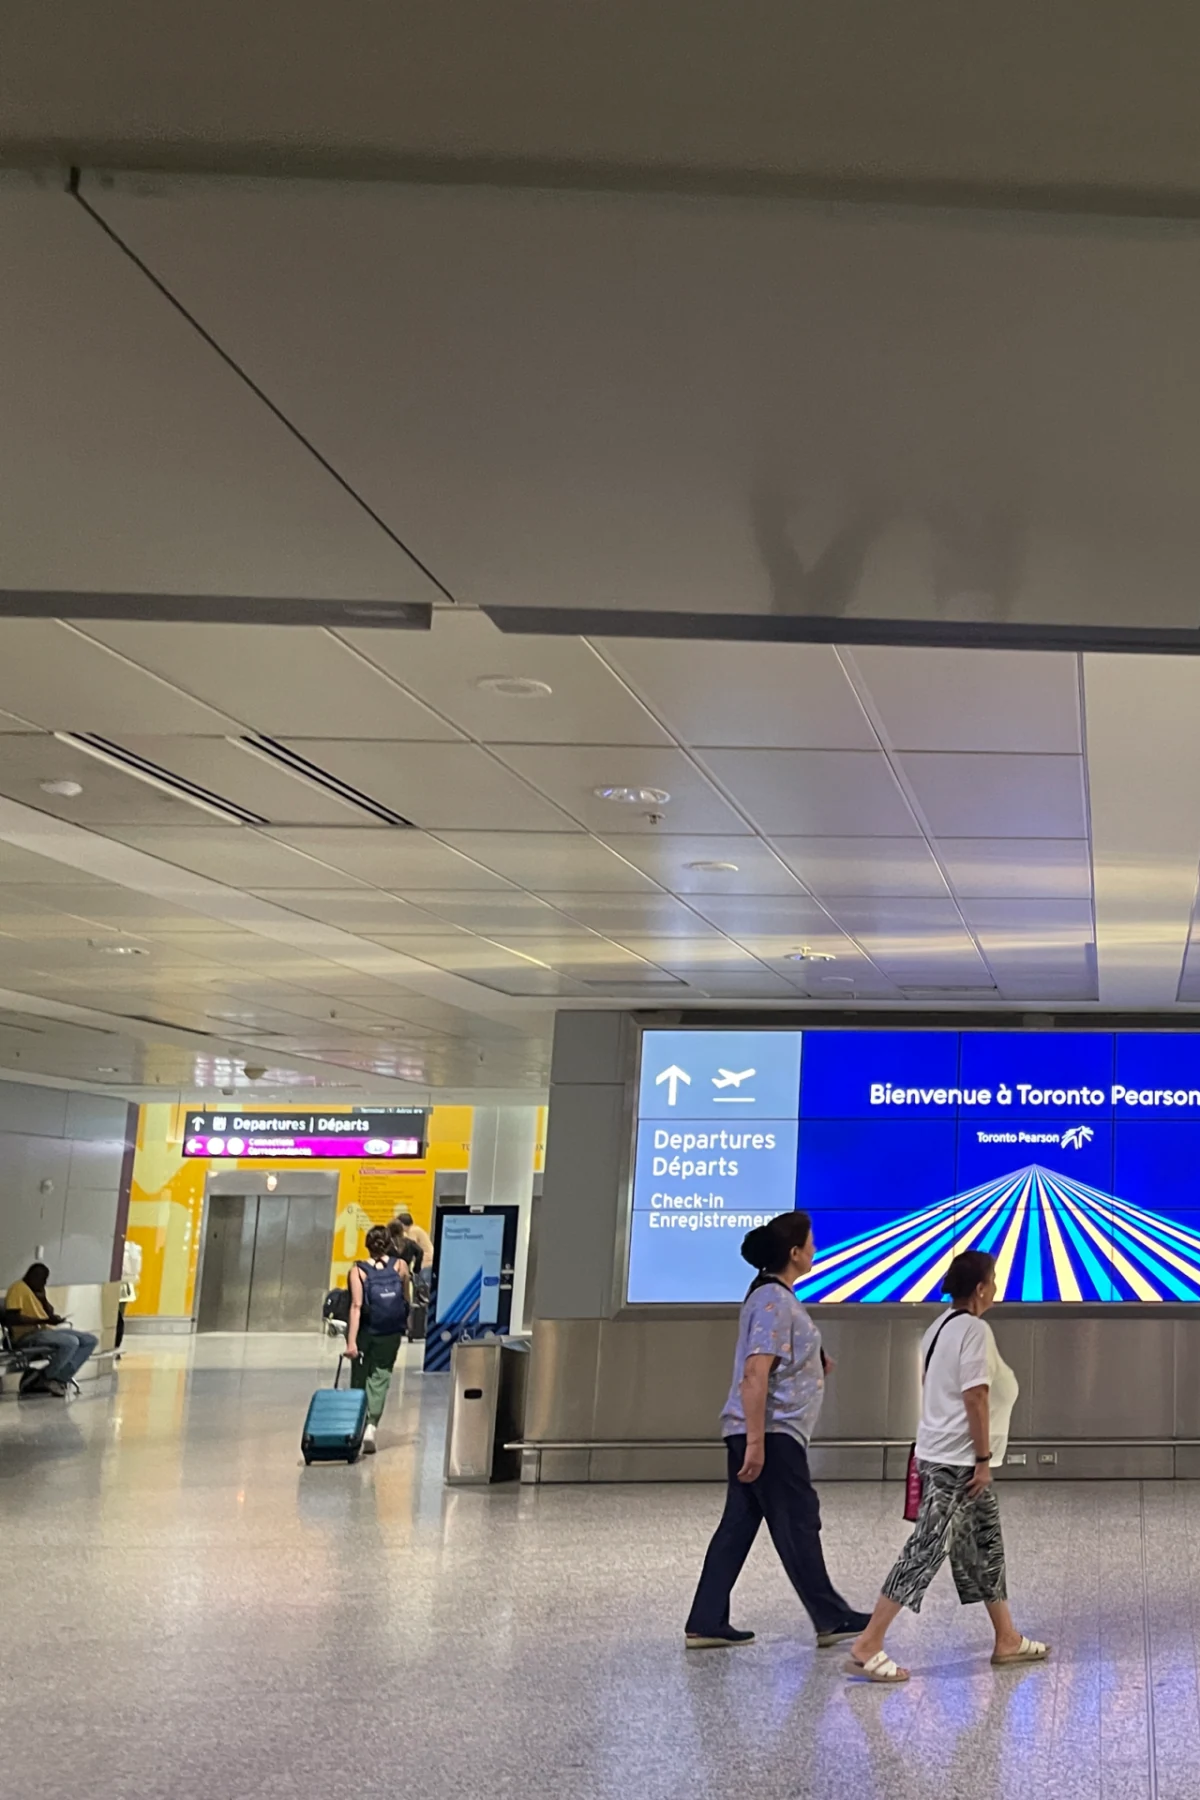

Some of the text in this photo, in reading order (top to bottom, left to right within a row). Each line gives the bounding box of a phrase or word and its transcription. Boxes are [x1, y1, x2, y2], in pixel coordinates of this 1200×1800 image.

[870, 1083, 991, 1105] Bienvenue
[996, 1083, 1012, 1105] à
[1016, 1084, 1105, 1106] Toronto
[233, 1116, 370, 1133] Departures Départs
[653, 1129, 776, 1153] Departures
[976, 1131, 1060, 1144] Toronto Pearson
[652, 1155, 739, 1180] Départs
[650, 1192, 725, 1209] Check-in
[648, 1212, 779, 1232] Enregistremen
